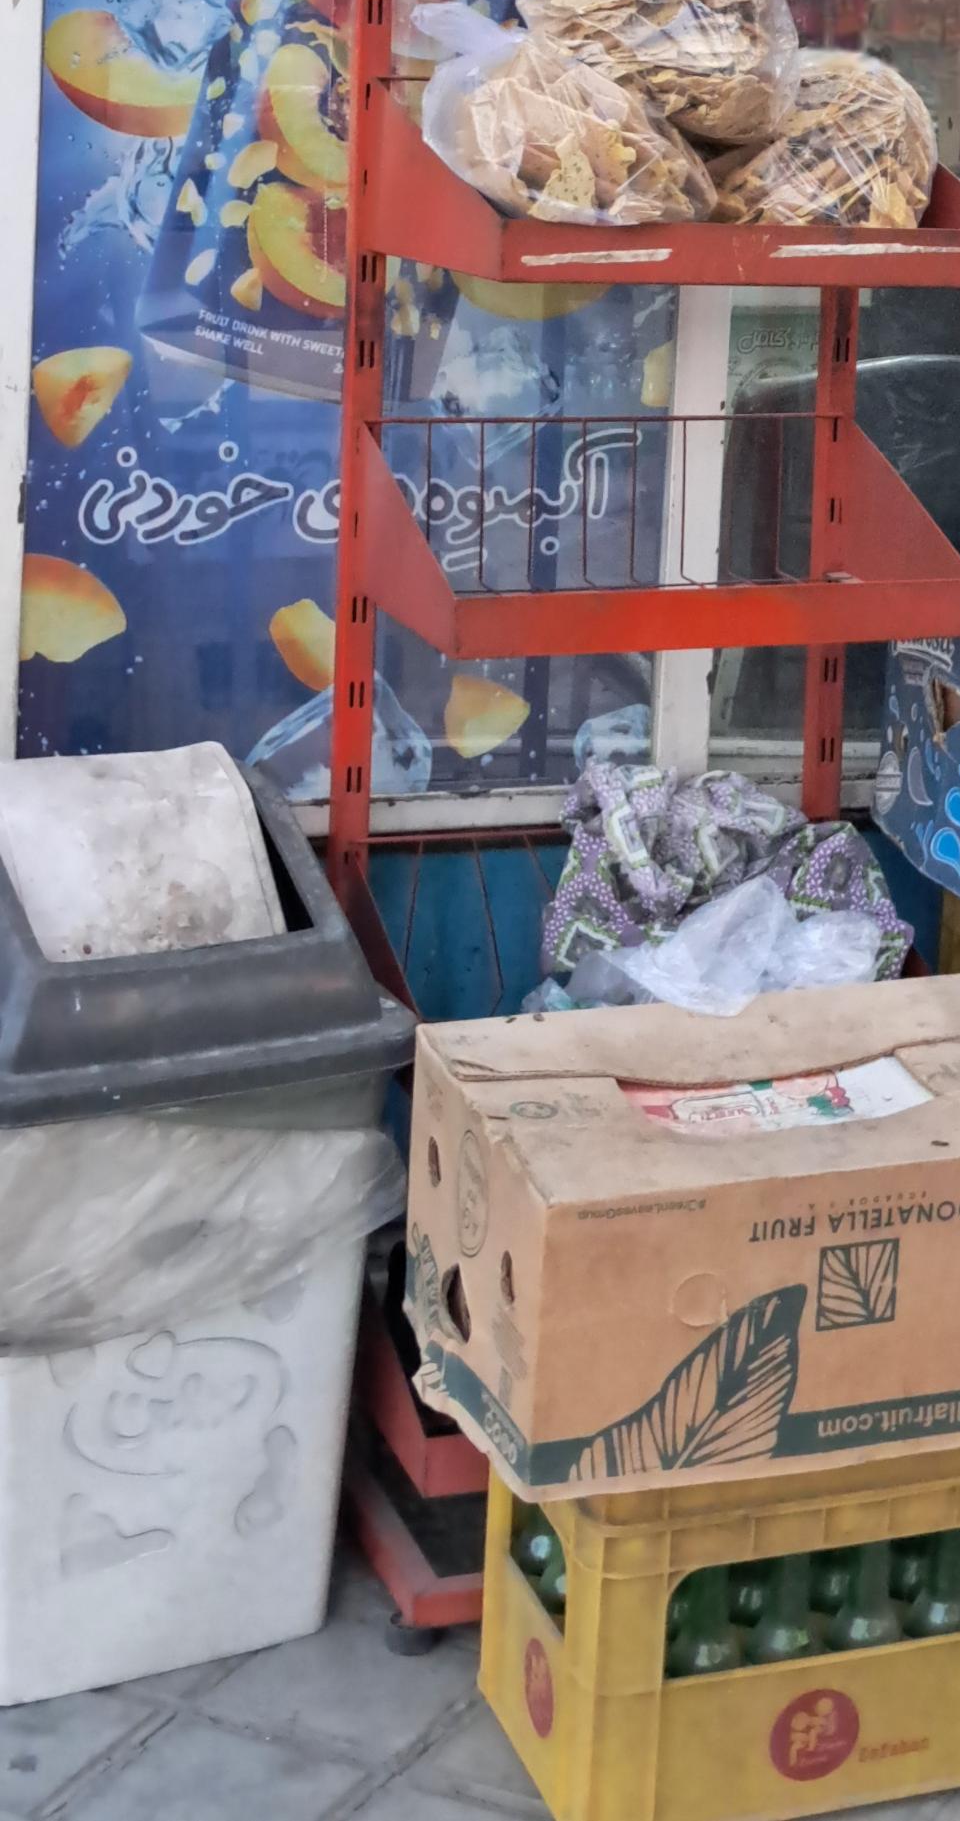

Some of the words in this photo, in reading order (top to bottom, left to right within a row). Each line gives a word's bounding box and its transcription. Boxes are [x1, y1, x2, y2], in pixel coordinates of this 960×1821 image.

[194, 324, 230, 346] SHAKE
[233, 336, 264, 355] WELL
[198, 309, 229, 328] FRUIT
[232, 319, 268, 340] DRINK
[270, 330, 302, 348] WITH
[302, 340, 345, 358] SWEET
[749, 1213, 816, 1244] FRUIT
